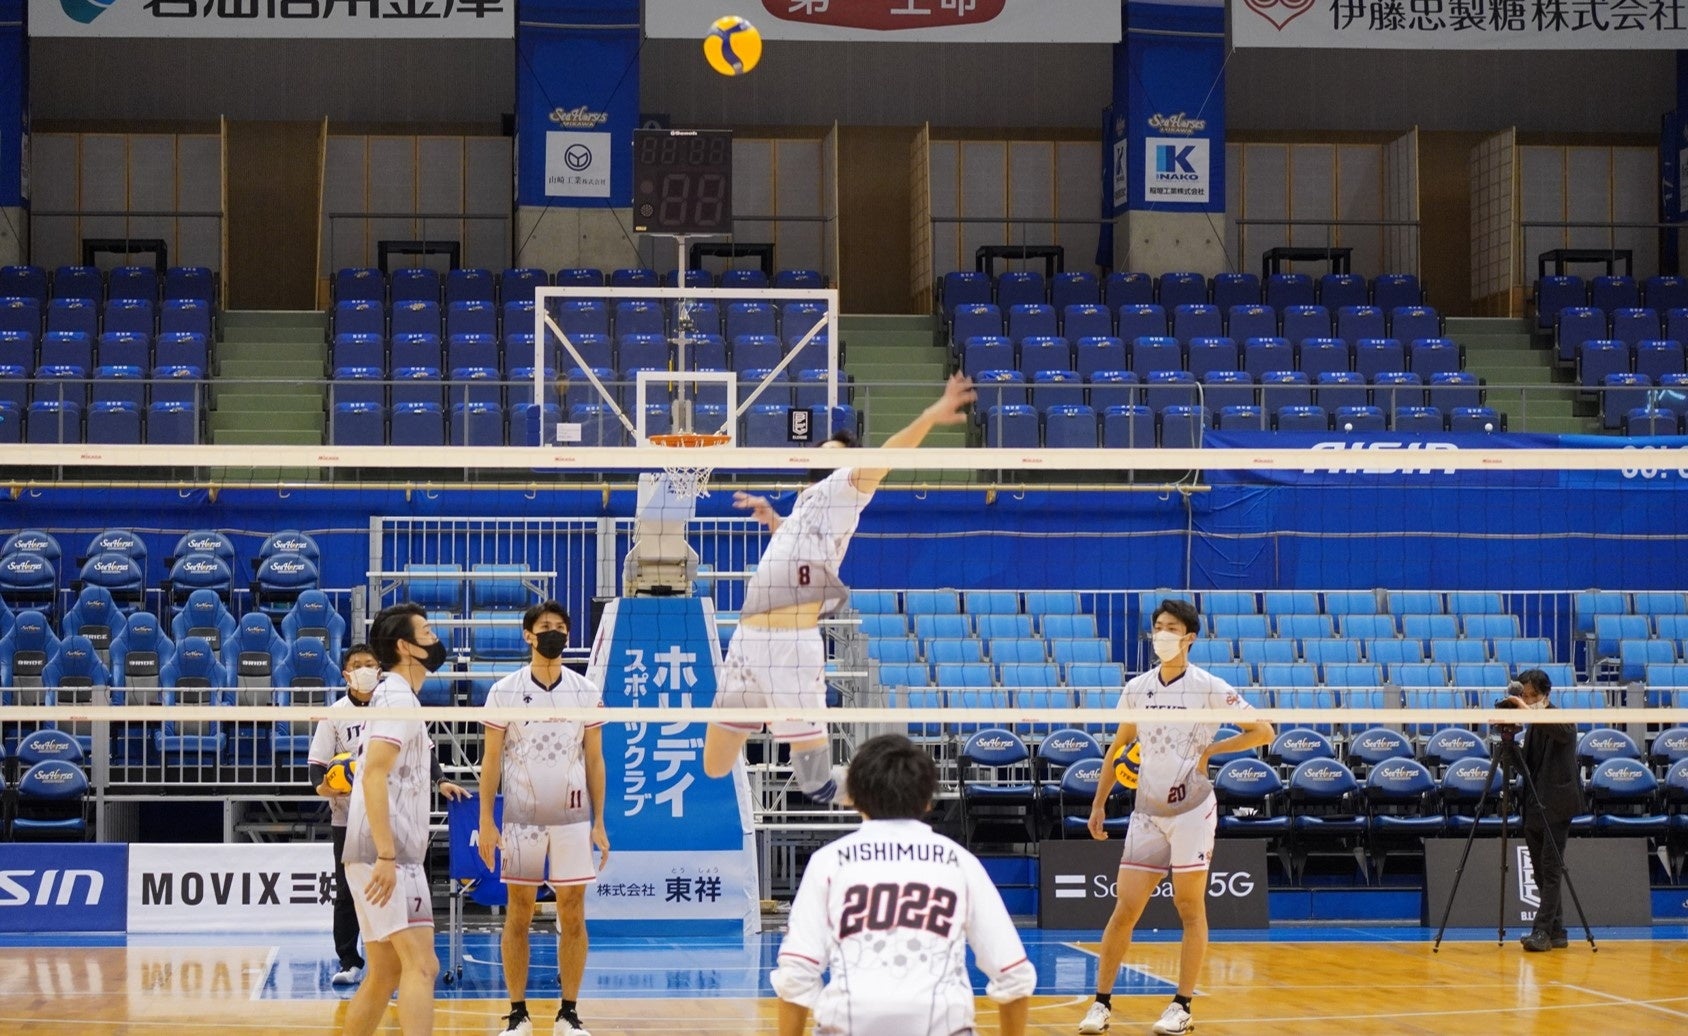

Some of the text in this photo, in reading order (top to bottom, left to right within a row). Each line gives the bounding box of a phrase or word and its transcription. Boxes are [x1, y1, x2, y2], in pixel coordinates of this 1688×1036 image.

[1156, 173, 1199, 181] INAKO
[799, 565, 810, 586] 8
[569, 789, 582, 809] 11
[1167, 783, 1186, 804] 20
[838, 842, 961, 867] NISHIMURA
[597, 876, 722, 903] 株式会社 東祥
[1208, 872, 1254, 897] 5G
[413, 897, 422, 913] 7
[839, 882, 958, 940] 2022
